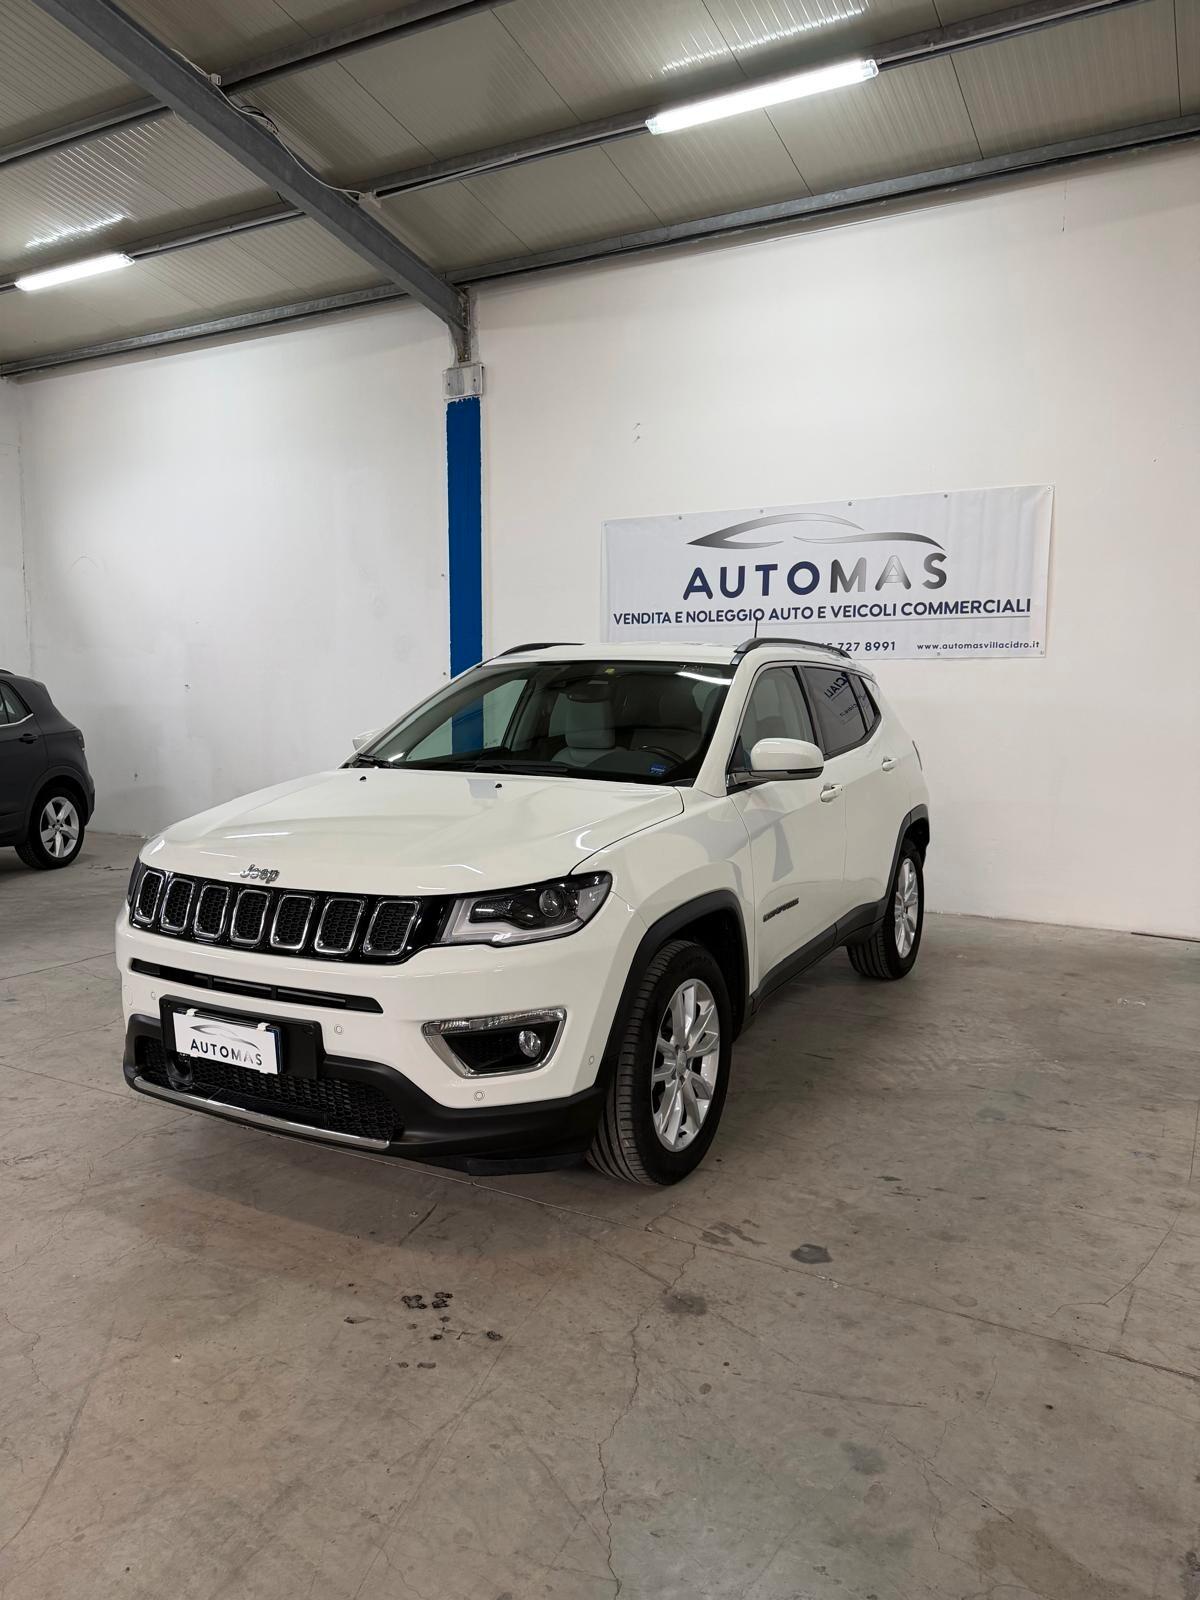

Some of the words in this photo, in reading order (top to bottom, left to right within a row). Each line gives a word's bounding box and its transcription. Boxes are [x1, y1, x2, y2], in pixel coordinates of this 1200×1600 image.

[683, 553, 948, 601] AUTOMAS
[613, 611, 672, 625] VENDITA
[675, 611, 683, 623] E
[686, 608, 765, 623] NOLEGGIO
[768, 606, 814, 621] AUTO
[817, 605, 827, 619] E
[830, 603, 897, 618] VEICOLI
[900, 598, 1032, 616] COMMERCIALI
[864, 640, 896, 652] 8991
[917, 640, 1040, 650] www.automasvillacidro.it
[240, 864, 280, 884] Jeep
[190, 1038, 263, 1066] AUTOMAS
